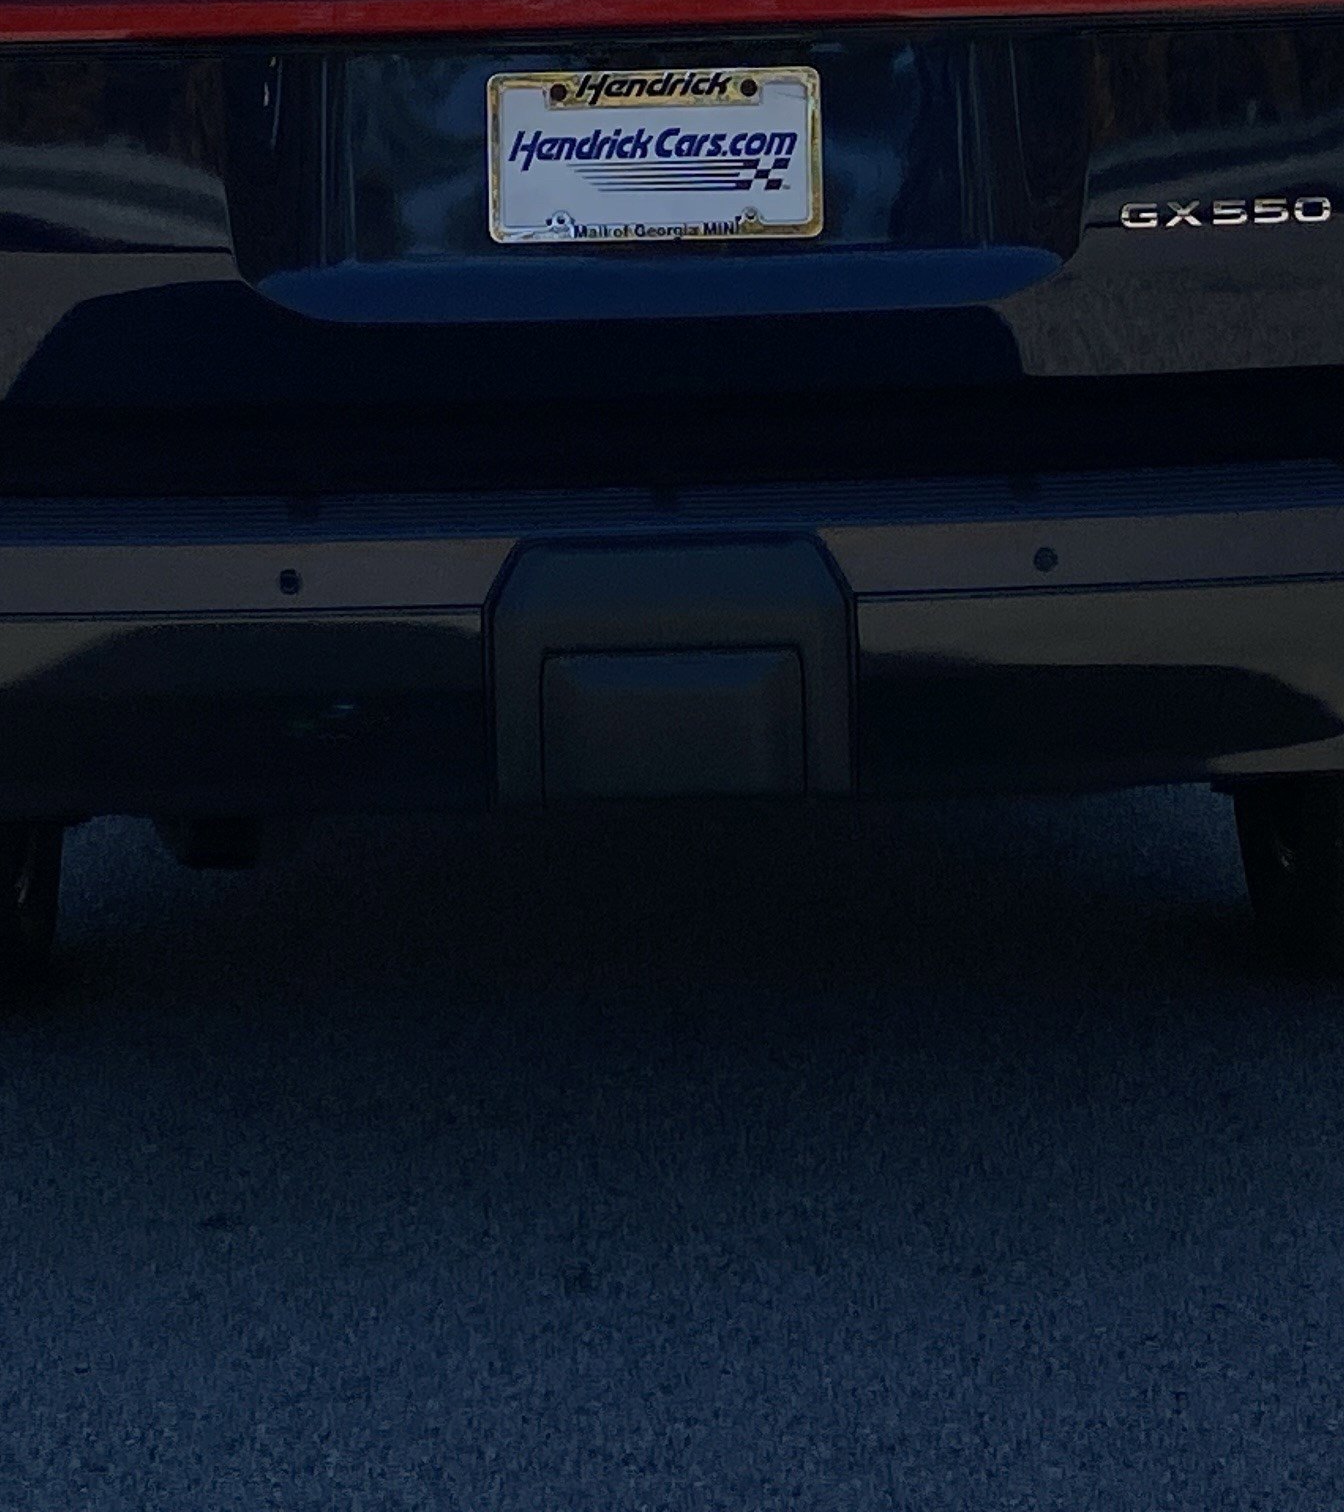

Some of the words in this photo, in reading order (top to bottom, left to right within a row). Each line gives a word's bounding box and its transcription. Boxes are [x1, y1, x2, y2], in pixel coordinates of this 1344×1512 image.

[575, 72, 733, 105] Hendrick
[613, 224, 628, 237] of
[634, 223, 699, 238] Georgia
